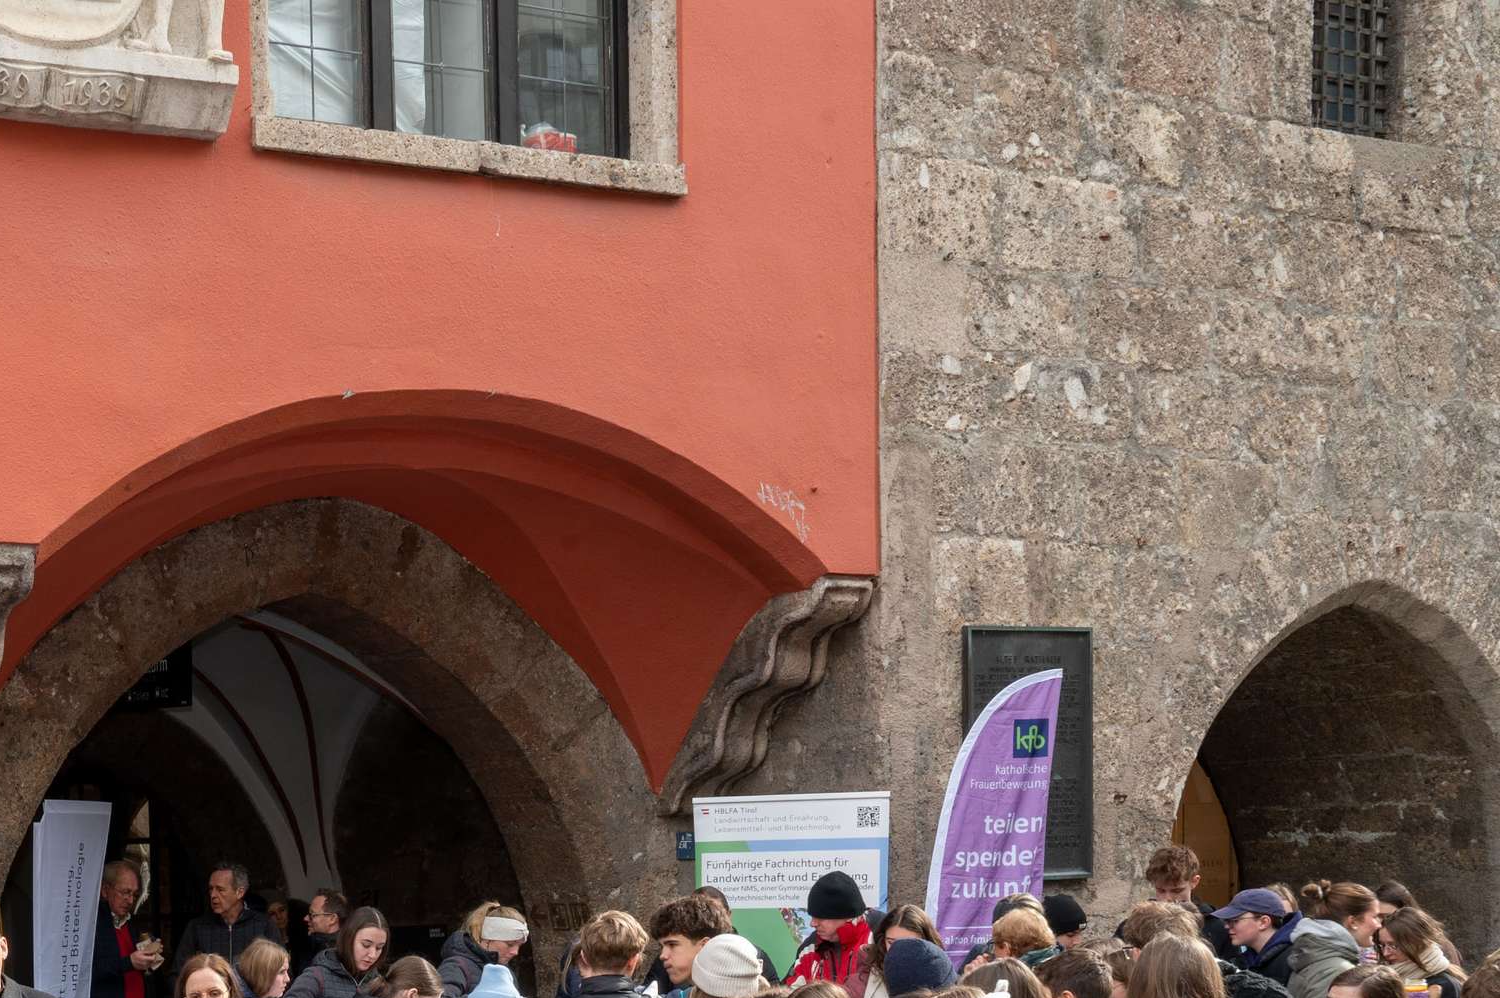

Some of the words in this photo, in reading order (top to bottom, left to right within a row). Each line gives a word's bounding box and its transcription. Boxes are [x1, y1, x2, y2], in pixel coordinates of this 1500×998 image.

[984, 812, 1042, 834] teilen
[766, 858, 831, 870] Fachrichtung
[834, 857, 849, 867] für
[706, 873, 785, 883] Landwirtschaft
[789, 872, 808, 881] und
[70, 842, 85, 956] Biotechnologie
